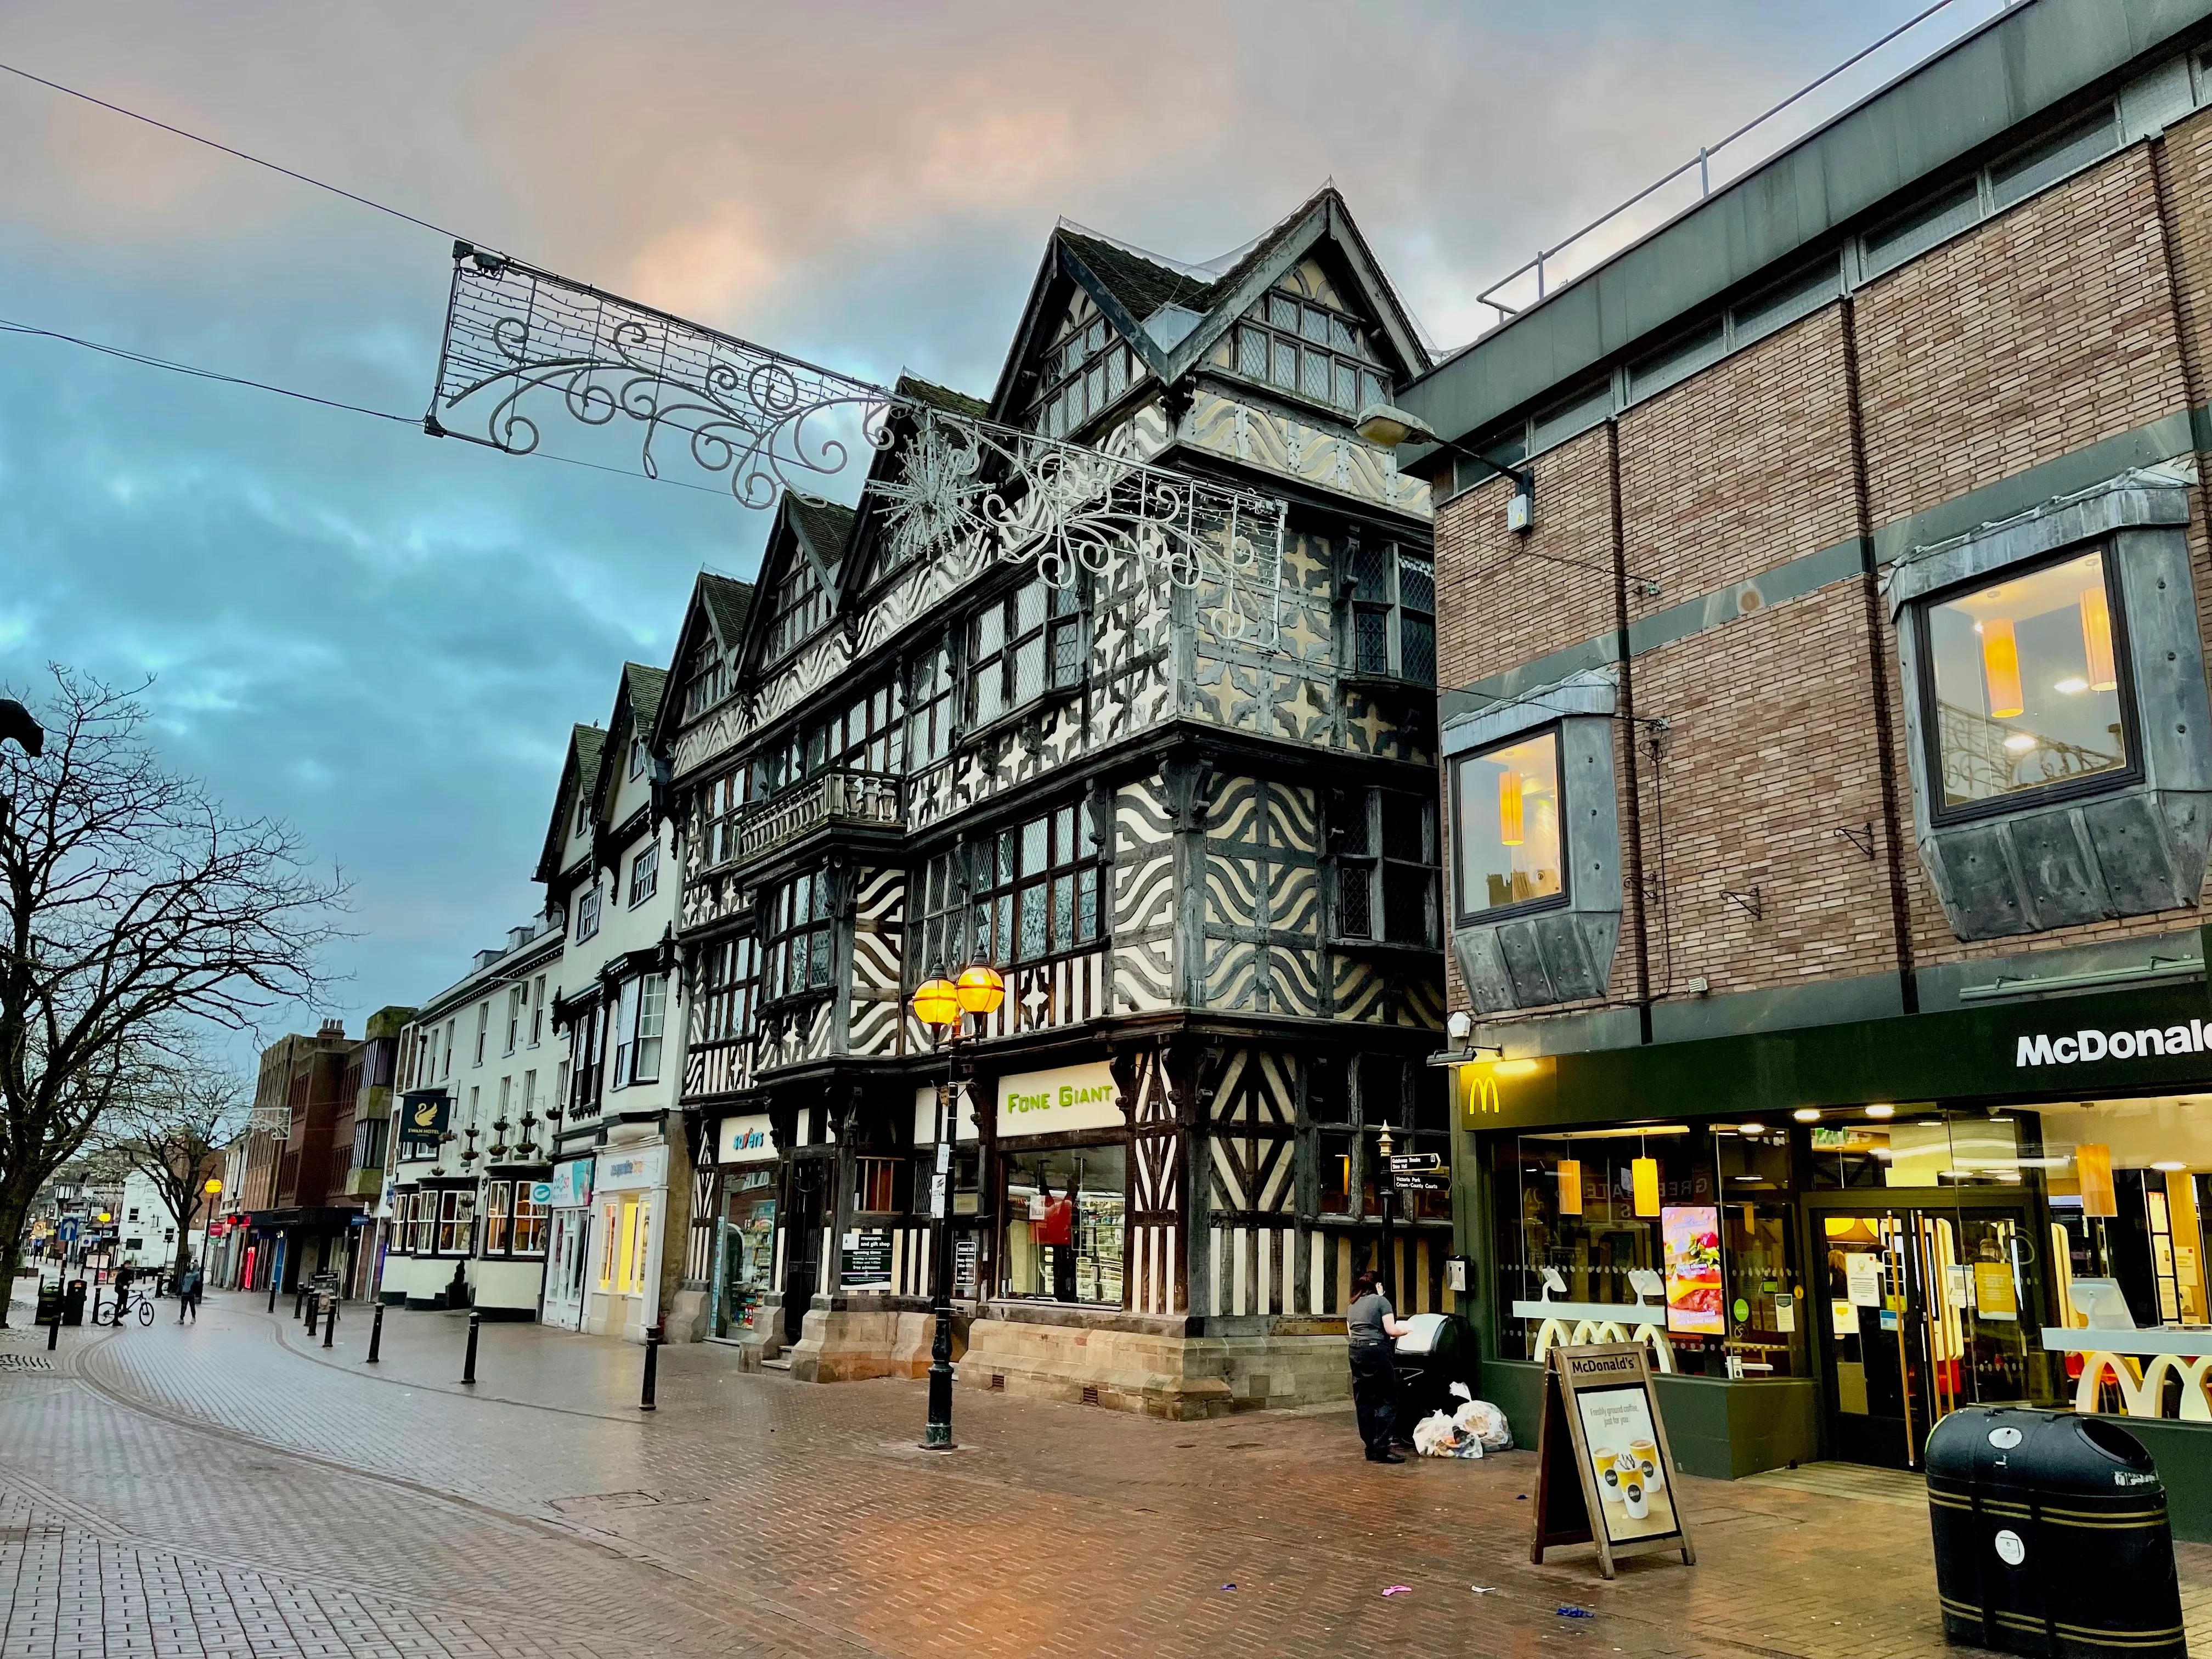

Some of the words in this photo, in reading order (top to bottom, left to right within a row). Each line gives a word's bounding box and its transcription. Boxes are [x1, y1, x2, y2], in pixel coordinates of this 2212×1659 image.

[733, 1127, 764, 1150] savers
[1572, 1357, 1634, 1373] McDonald's
[1590, 1407, 1607, 1417] Freshly
[1607, 1404, 1623, 1417] ground
